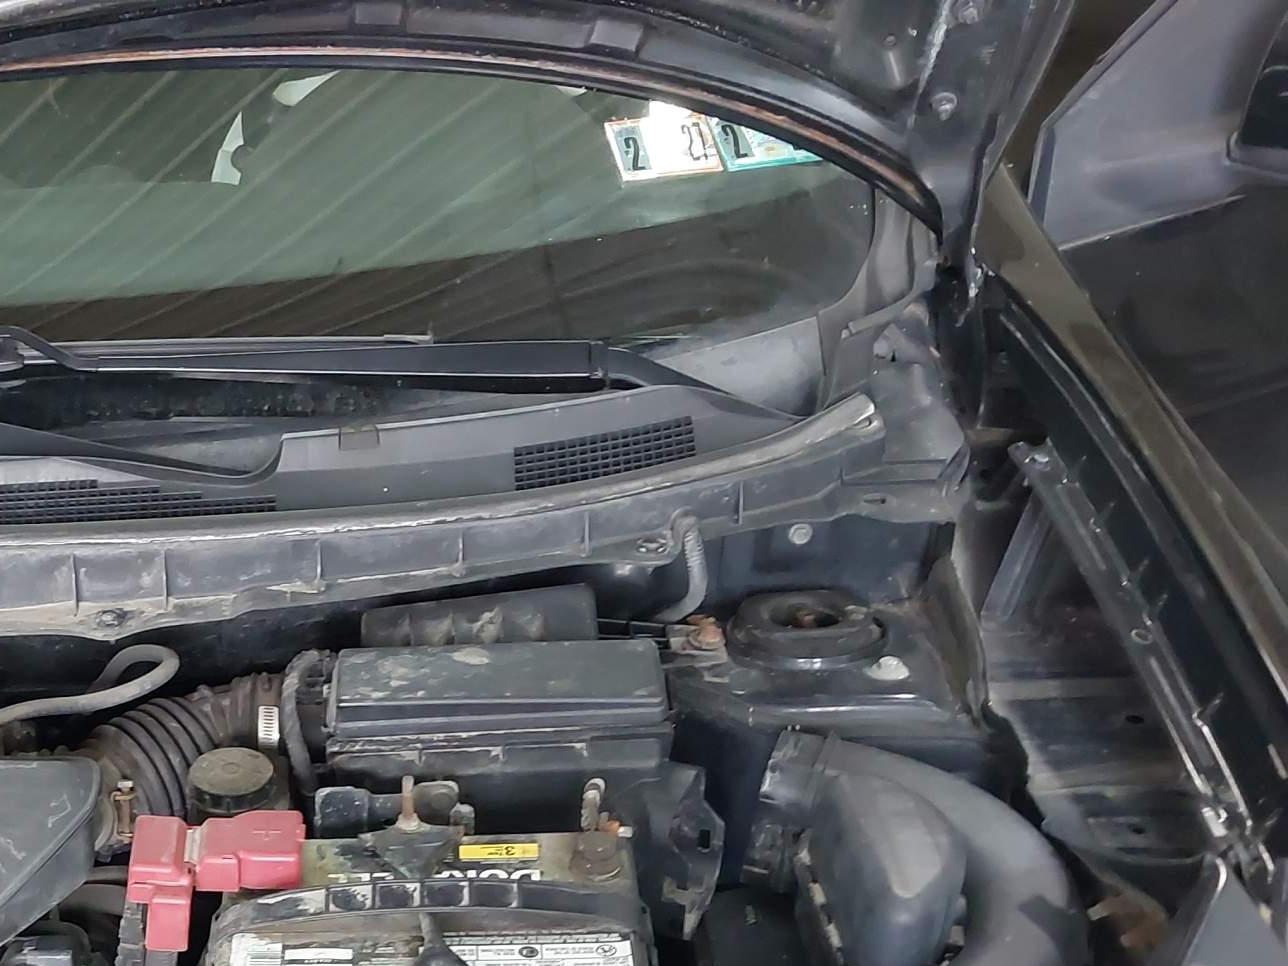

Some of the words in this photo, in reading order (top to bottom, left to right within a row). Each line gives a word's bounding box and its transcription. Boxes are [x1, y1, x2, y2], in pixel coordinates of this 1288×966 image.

[624, 137, 646, 171] 2
[721, 124, 749, 159] 2
[505, 846, 516, 856] 3
